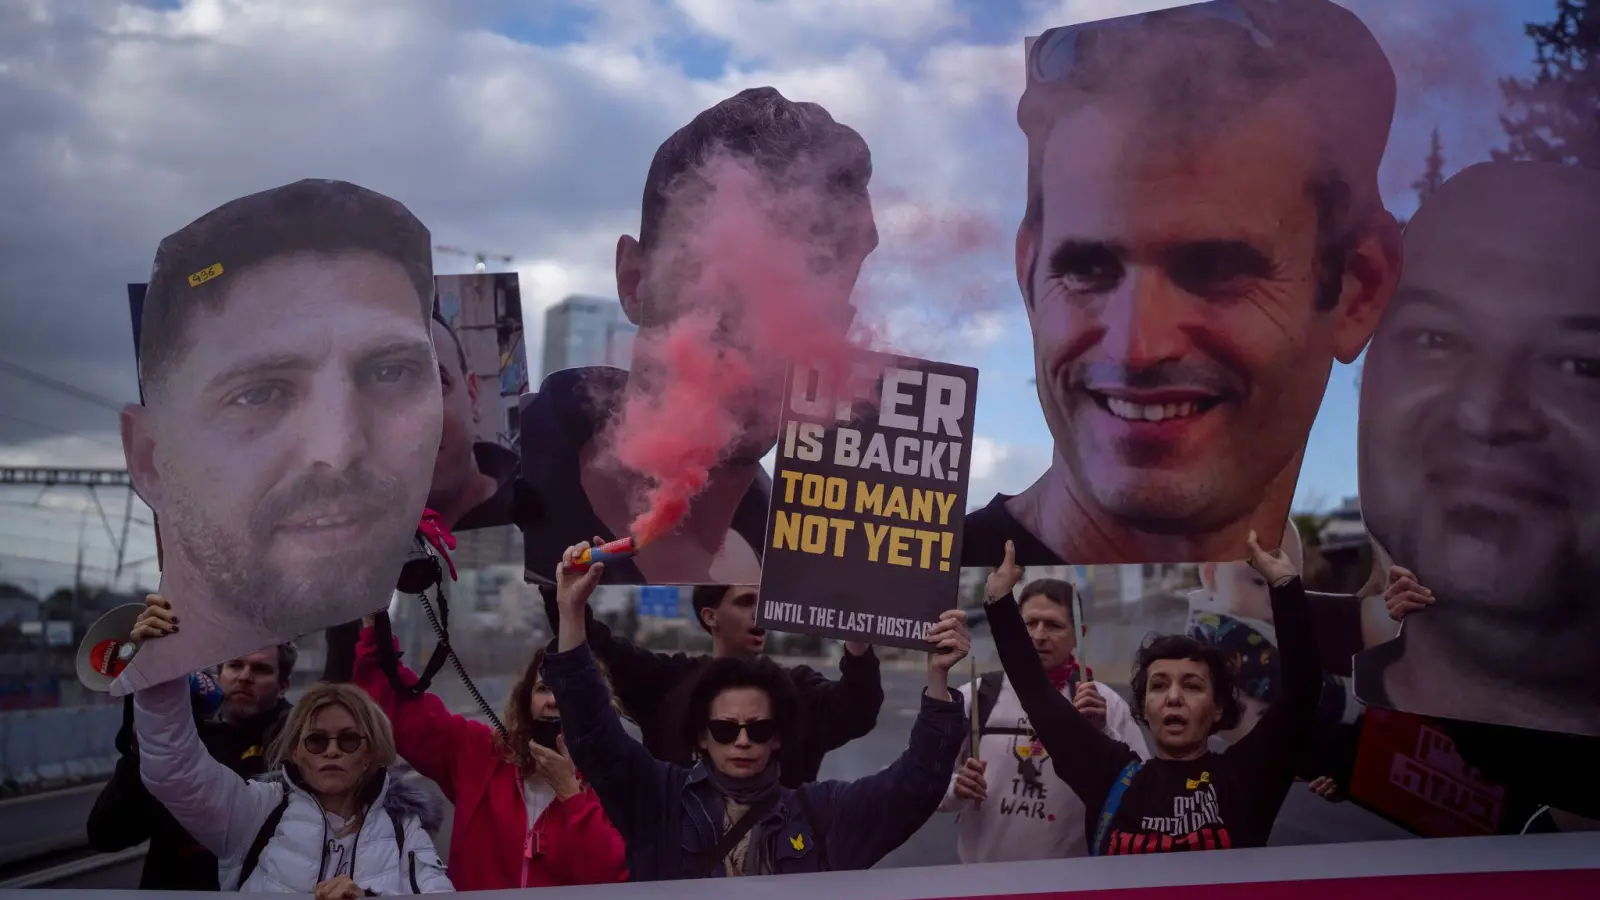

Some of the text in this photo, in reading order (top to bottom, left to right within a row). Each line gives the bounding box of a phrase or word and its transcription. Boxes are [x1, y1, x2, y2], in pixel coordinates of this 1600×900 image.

[783, 420, 962, 482] IS BACK!
[780, 470, 957, 525] TOO MANY
[772, 510, 954, 572] NOT YET!
[763, 600, 937, 641] UNTIL THE LAST HOSTAG
[1012, 778, 1047, 799] THE
